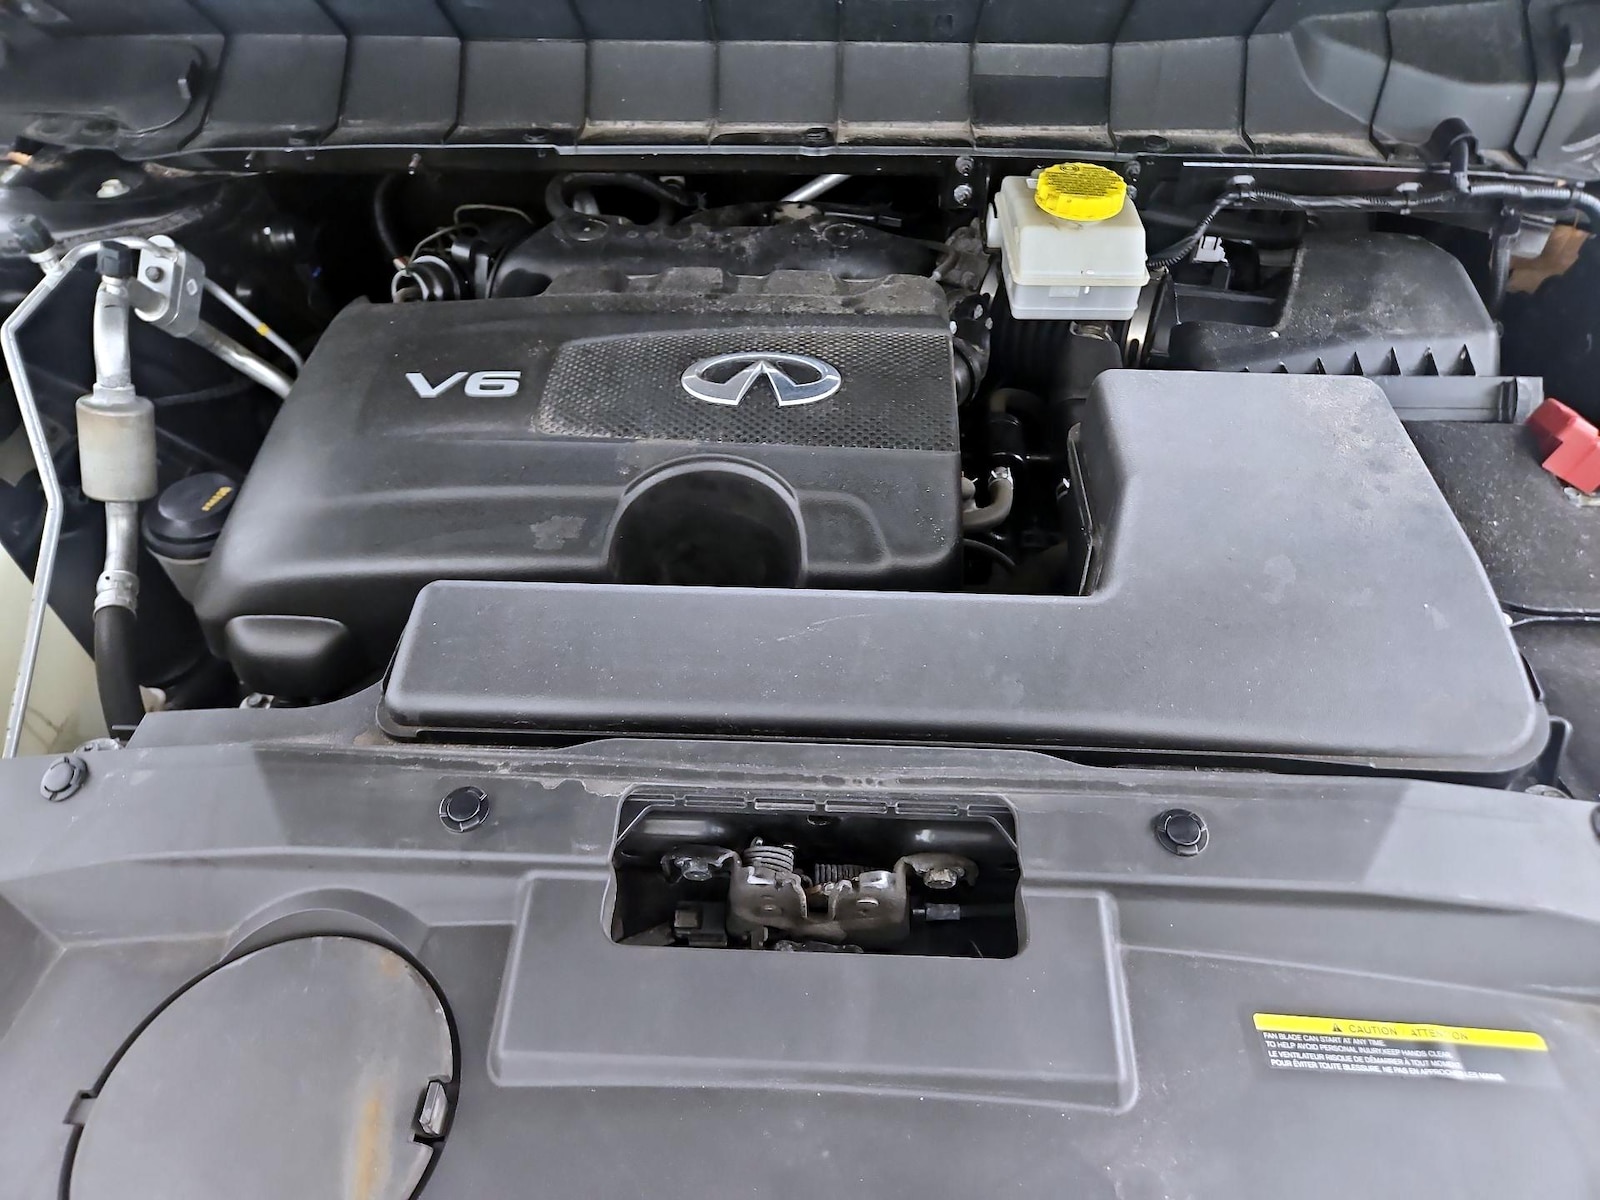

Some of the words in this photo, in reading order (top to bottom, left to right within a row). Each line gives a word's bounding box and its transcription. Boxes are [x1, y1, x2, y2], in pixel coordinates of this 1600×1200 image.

[405, 370, 521, 398] V6
[1263, 1032, 1278, 1040] FAN
[1278, 1033, 1302, 1041] BLADE
[1303, 1034, 1320, 1042] CAN
[1348, 1024, 1398, 1036] CAUTION
[1410, 1028, 1469, 1040] ATTENON
[1278, 1041, 1296, 1049] HELP
[1297, 1042, 1319, 1051] AVOID
[1319, 1044, 1358, 1053] PERSONAL
[1401, 1049, 1427, 1057] HANDS
[1268, 1050, 1278, 1058] LE
[1278, 1051, 1325, 1061] VENTILATEUR
[1325, 1053, 1353, 1062] RISQUE
[1353, 1055, 1364, 1063] DE
[1411, 1059, 1430, 1067] TOUT
[1271, 1059, 1293, 1067] POUR
[1293, 1058, 1318, 1069] ÉVITER
[1319, 1062, 1342, 1071] TOUTE
[1393, 1066, 1408, 1075] PAS
